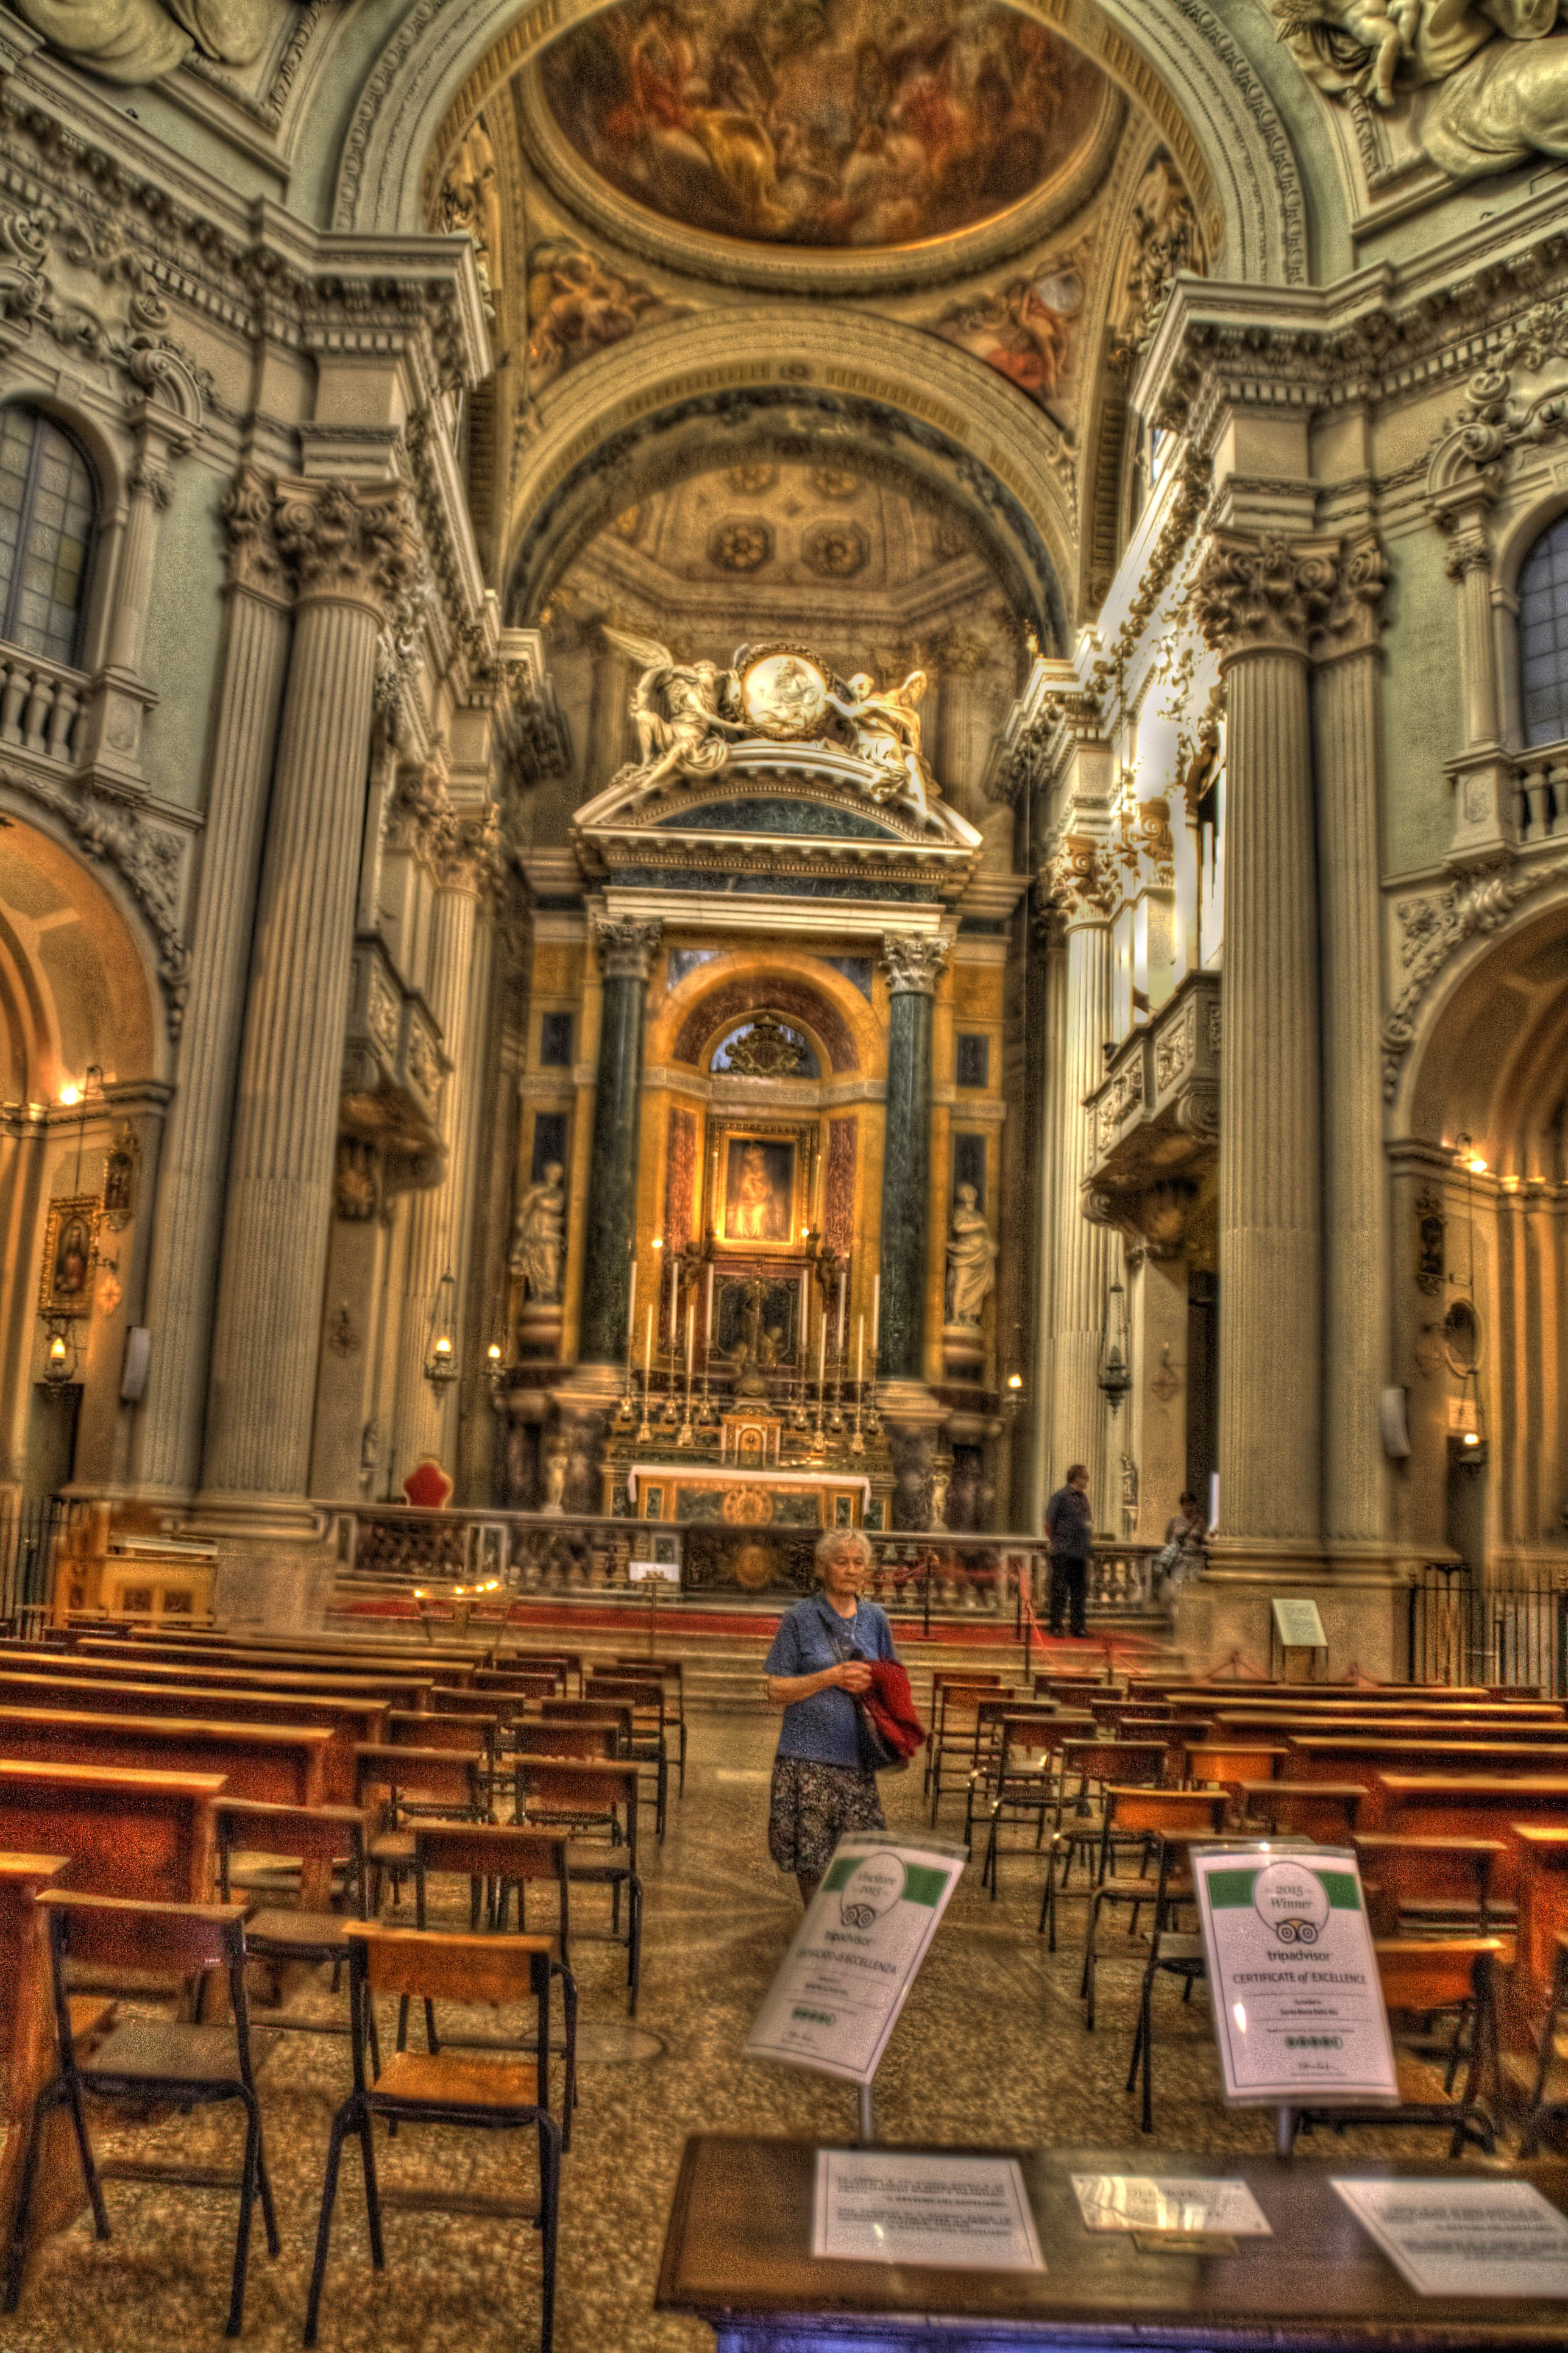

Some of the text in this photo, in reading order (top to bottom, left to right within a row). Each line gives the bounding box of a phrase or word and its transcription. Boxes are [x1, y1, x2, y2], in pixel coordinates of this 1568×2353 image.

[1276, 1885, 1303, 1896] 2015
[1271, 1898, 1311, 1909] Winner
[1268, 1949, 1330, 1963] tripadvisor
[845, 1954, 897, 1974] ECCELLENZA
[1233, 1973, 1366, 1985] CERTIFICATE of EXCELLENCE
